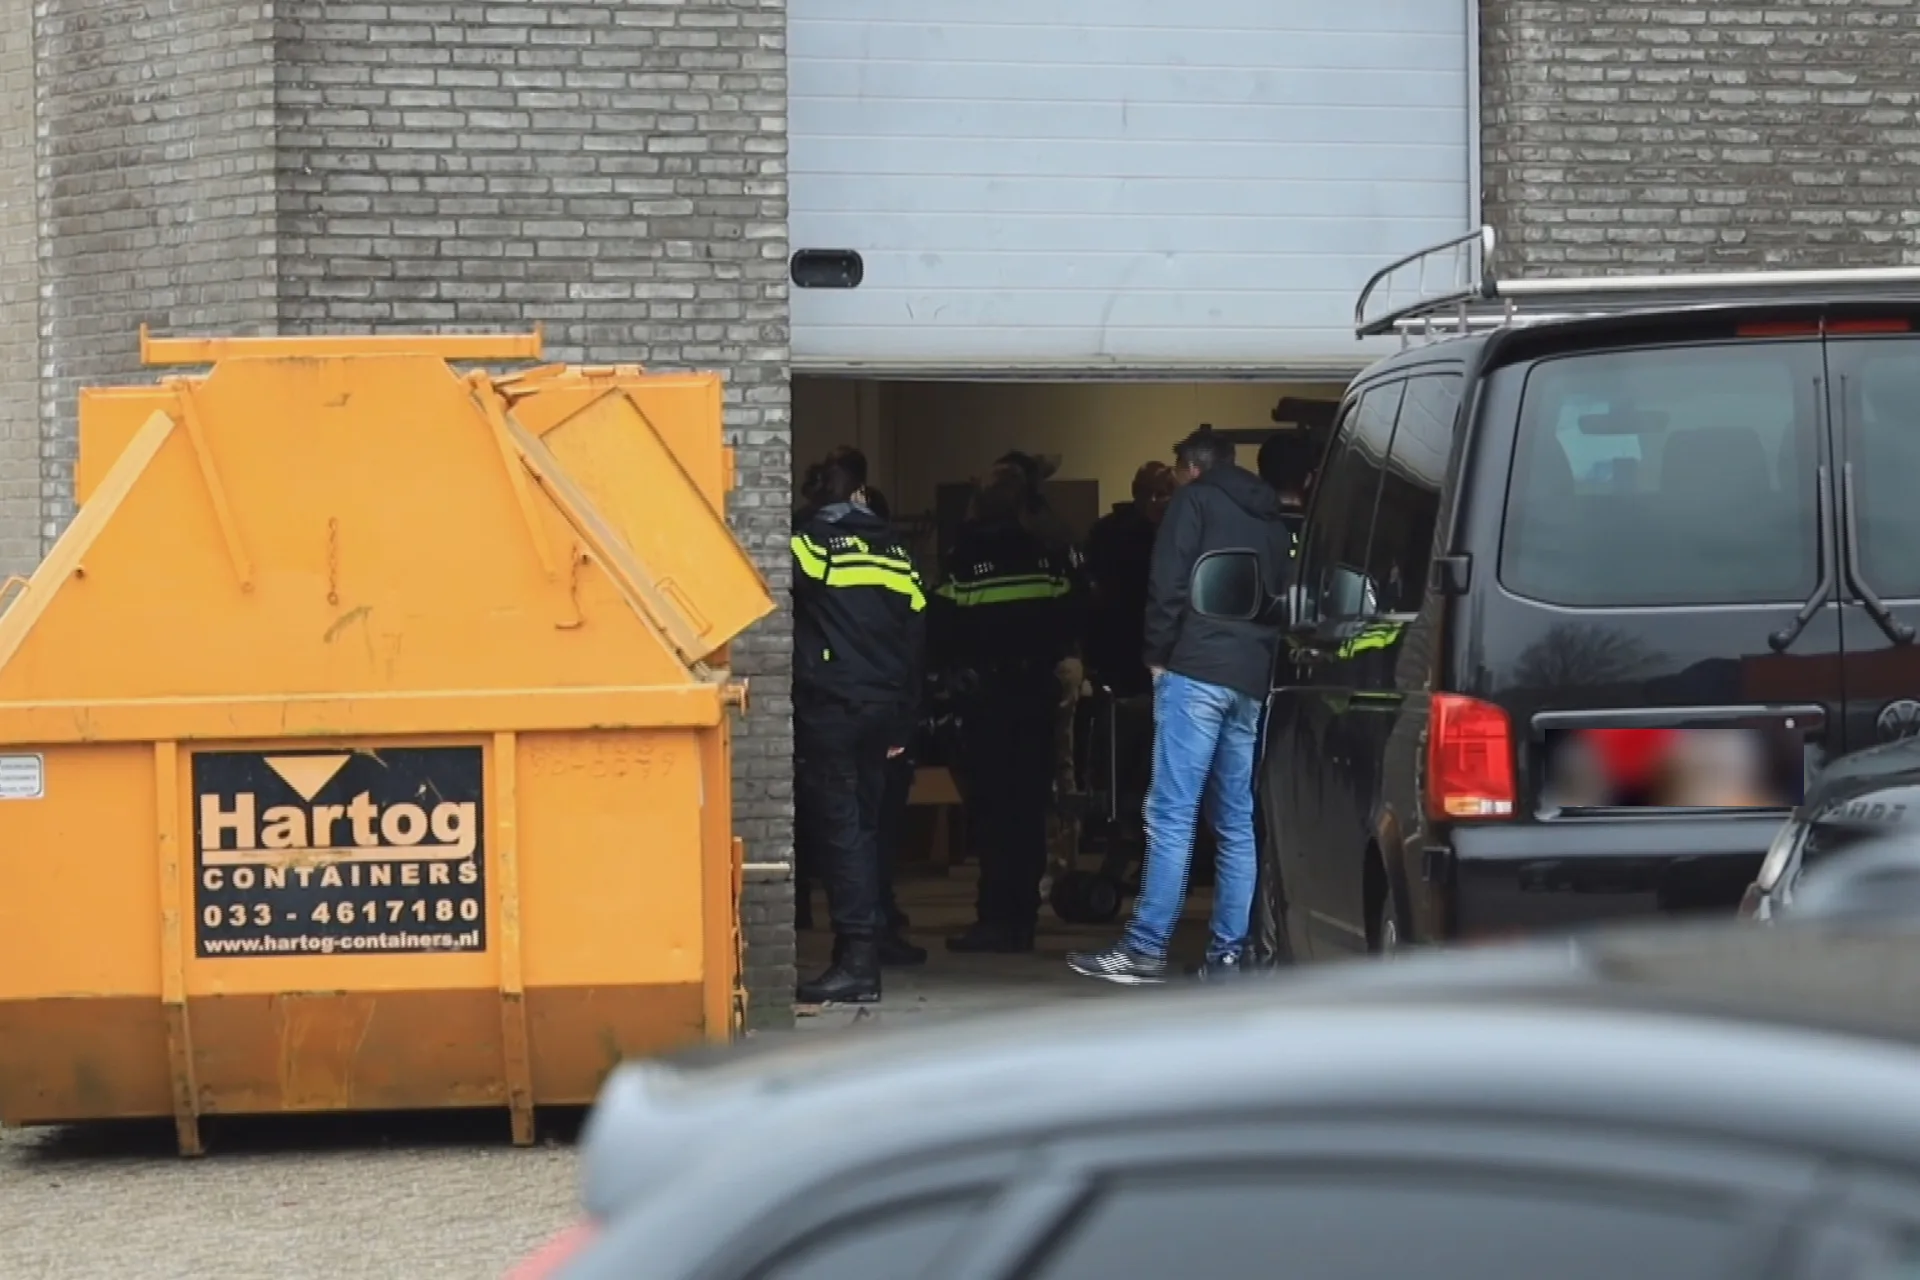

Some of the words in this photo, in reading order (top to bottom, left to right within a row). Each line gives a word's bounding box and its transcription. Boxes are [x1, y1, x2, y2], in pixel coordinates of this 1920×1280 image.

[200, 790, 477, 864] Hartog
[202, 863, 479, 890] CONTAINERS
[203, 902, 273, 927] 033
[311, 898, 480, 924] 4617180
[204, 930, 480, 953] www.hartog-containers.nl
